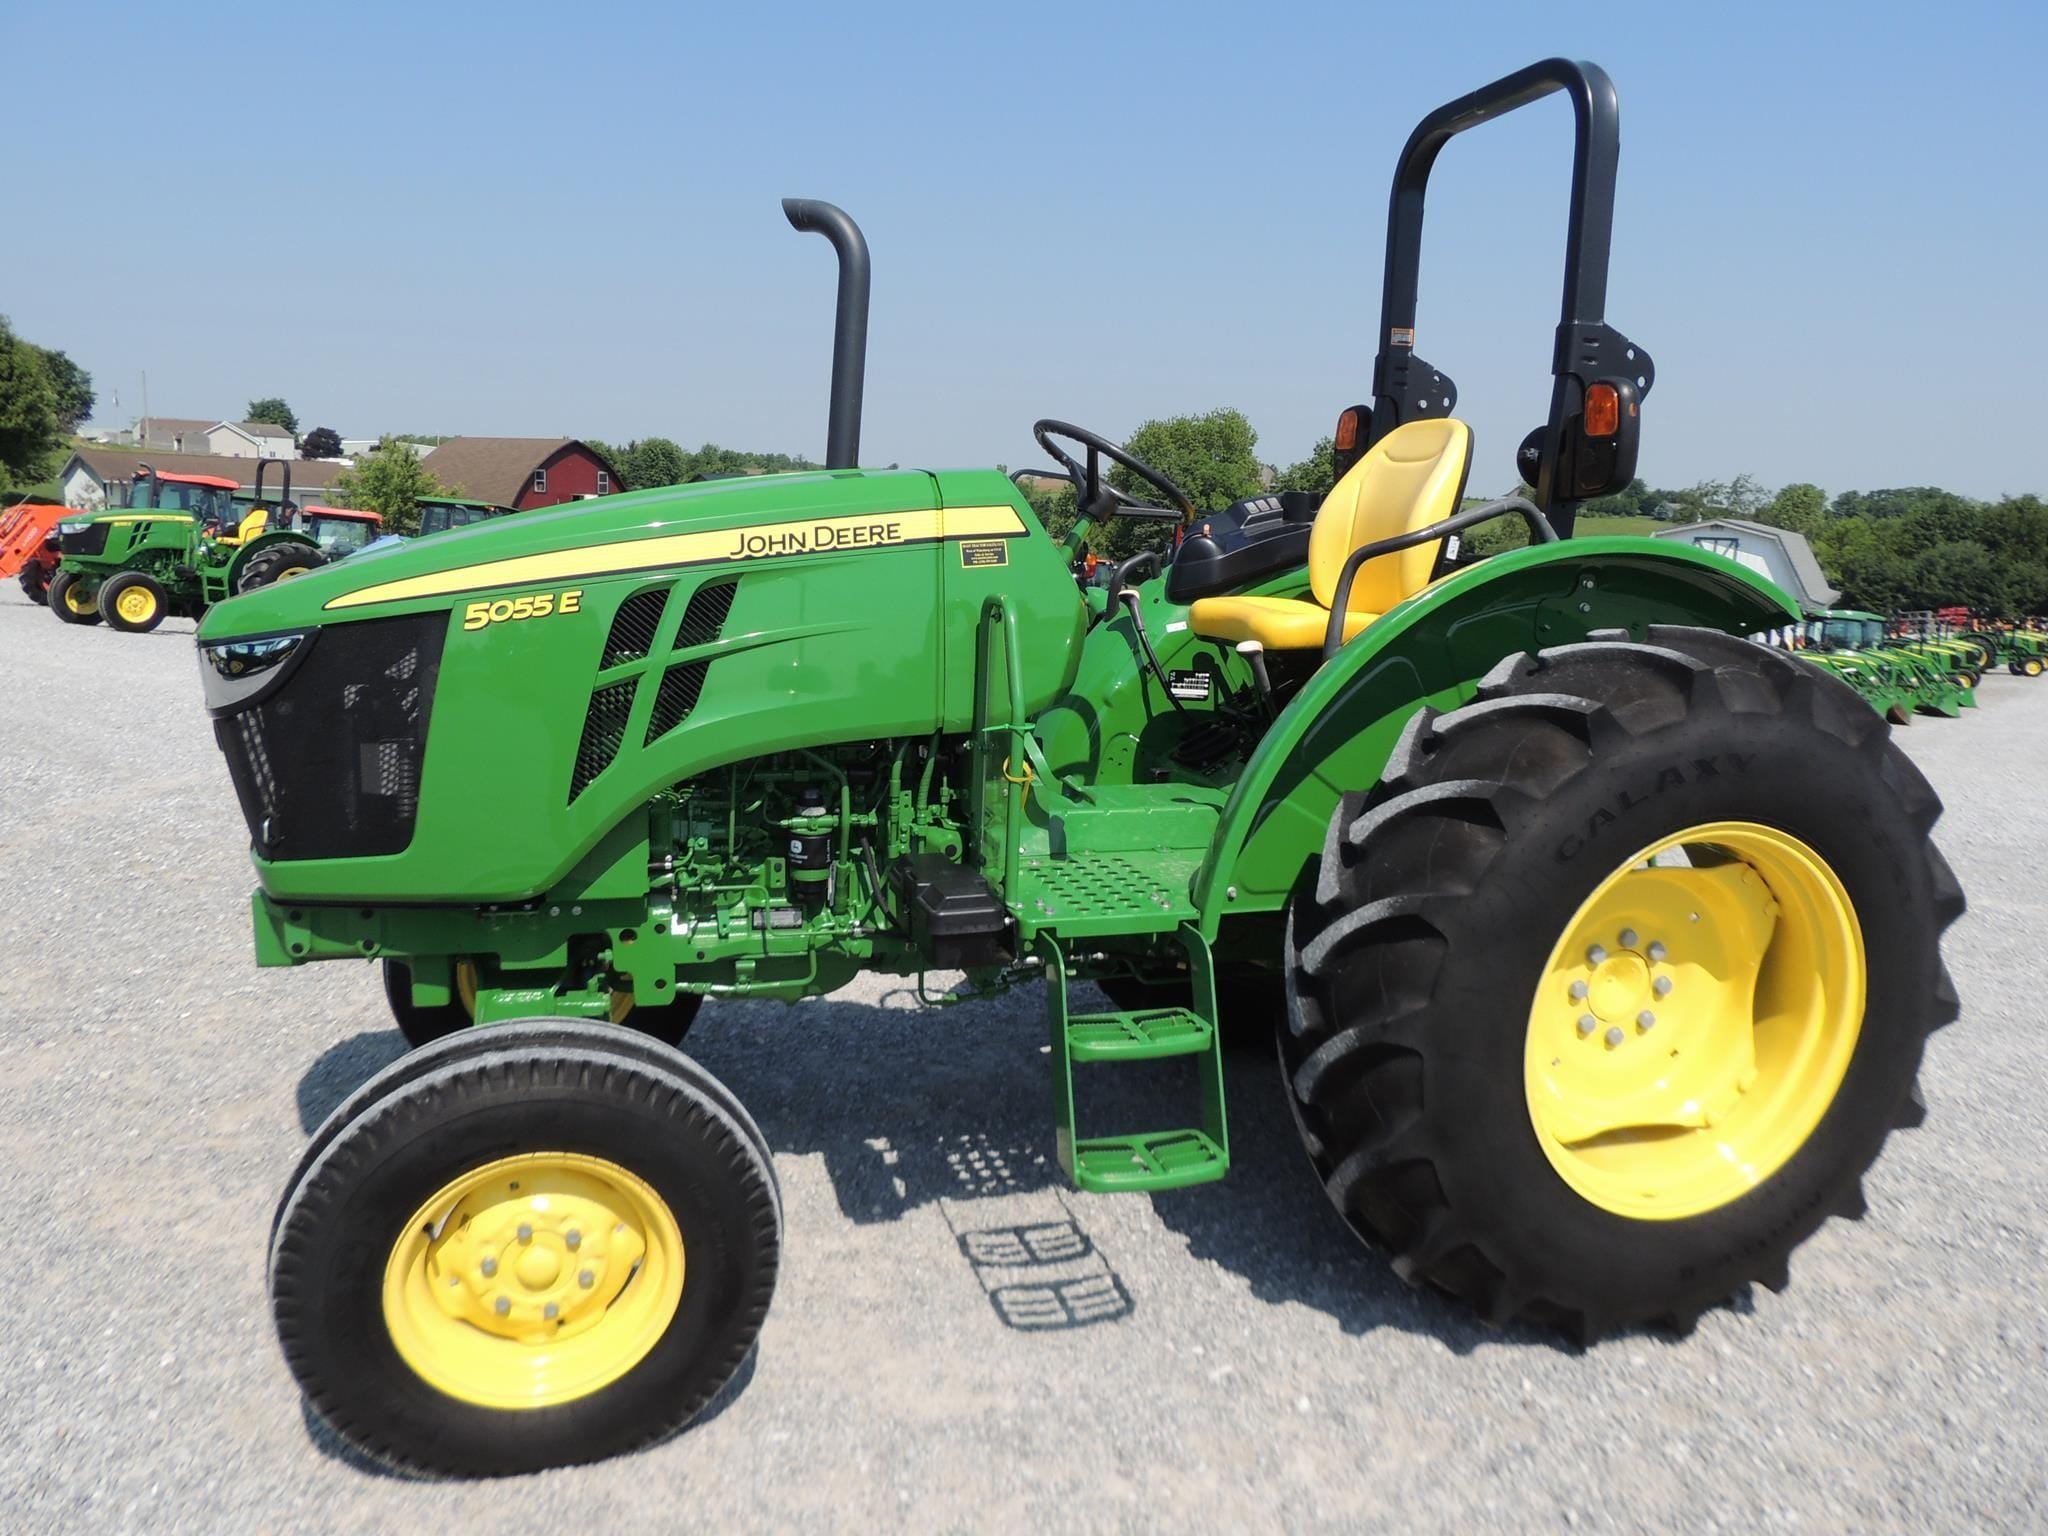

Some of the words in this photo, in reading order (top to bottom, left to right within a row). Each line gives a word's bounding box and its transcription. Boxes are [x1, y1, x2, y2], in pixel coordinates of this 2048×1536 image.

[730, 531, 806, 556] JOHN
[814, 523, 902, 548] DEERE
[463, 594, 554, 631] 5055
[559, 590, 583, 614] E
